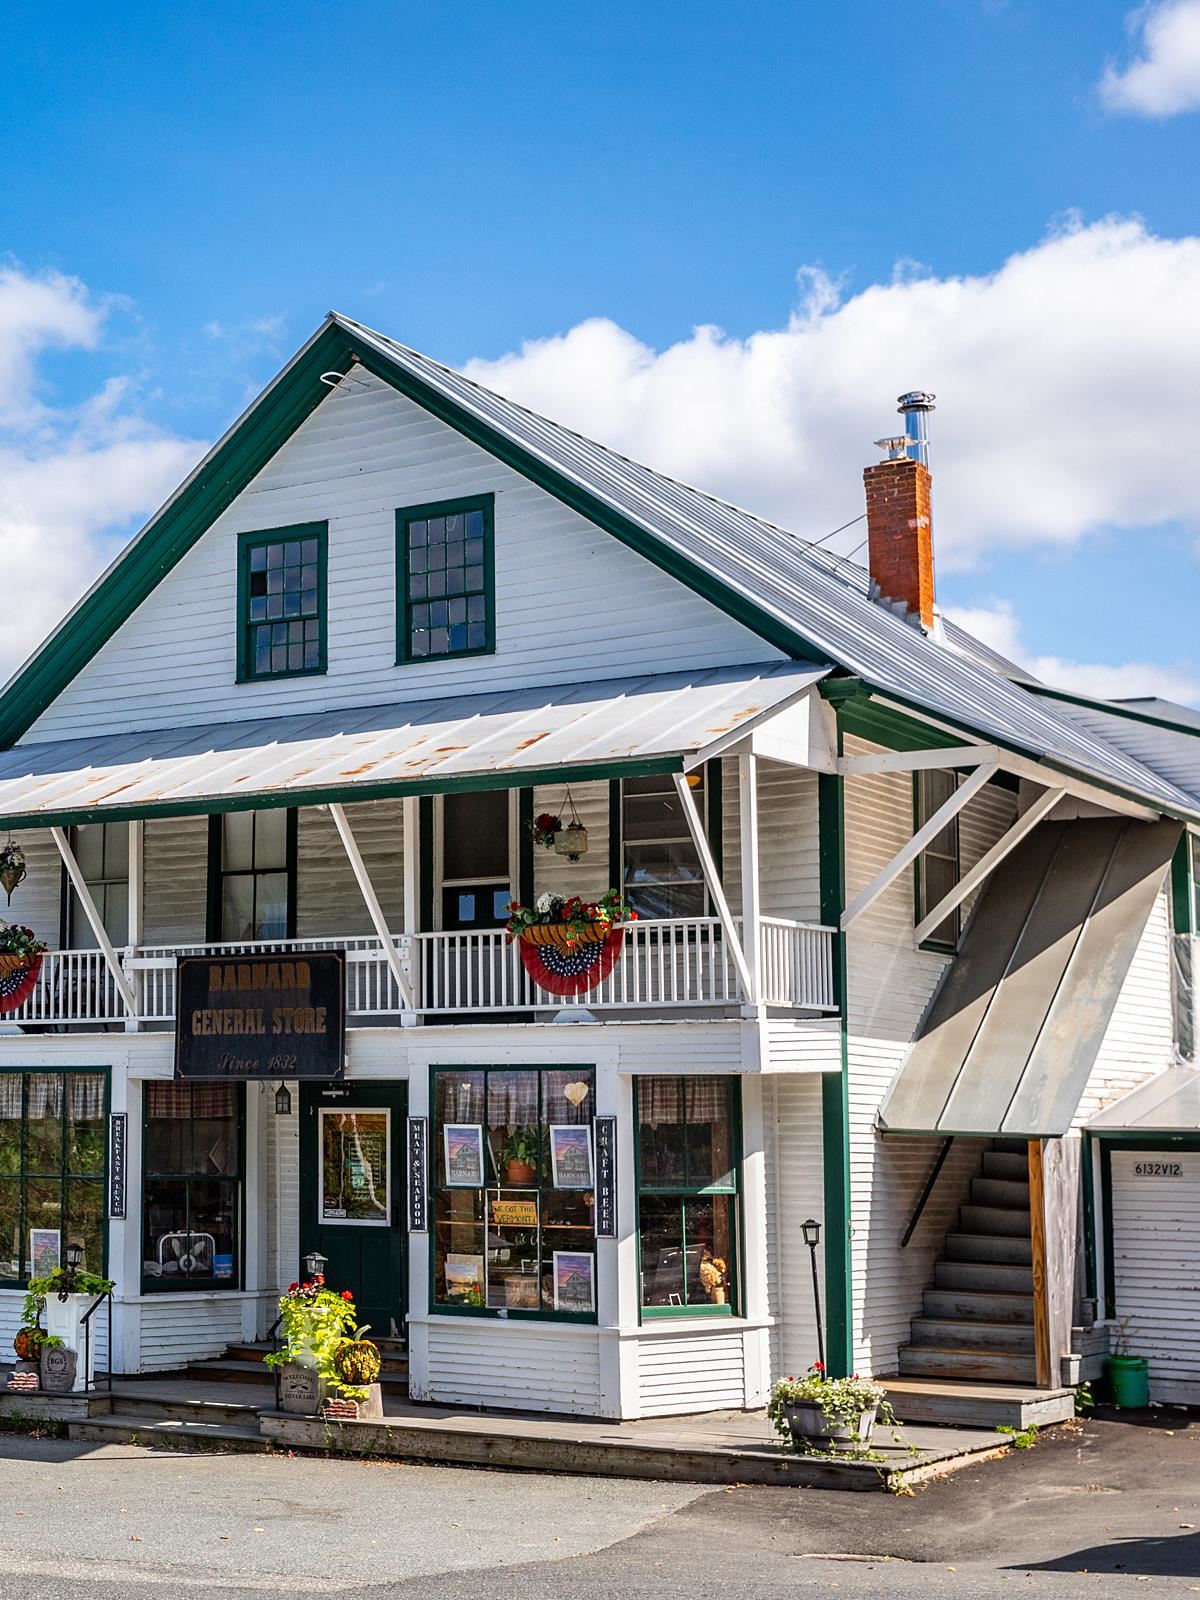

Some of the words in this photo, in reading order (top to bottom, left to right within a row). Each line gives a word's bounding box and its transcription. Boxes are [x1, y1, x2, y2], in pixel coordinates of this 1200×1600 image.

[209, 962, 311, 992] BARNARD
[192, 1008, 266, 1036] GENERAL
[272, 1007, 327, 1034] STORE
[218, 1052, 260, 1070] Since
[267, 1055, 297, 1069] 1832
[413, 1125, 421, 1155] MEAT
[601, 1125, 609, 1179] CRAFT
[1135, 1163, 1180, 1176] 6132V12
[505, 1205, 517, 1213] GOT
[602, 1187, 610, 1229] BEER
[50, 1357, 64, 1365] BGS
[283, 1374, 314, 1383] WELCOME
